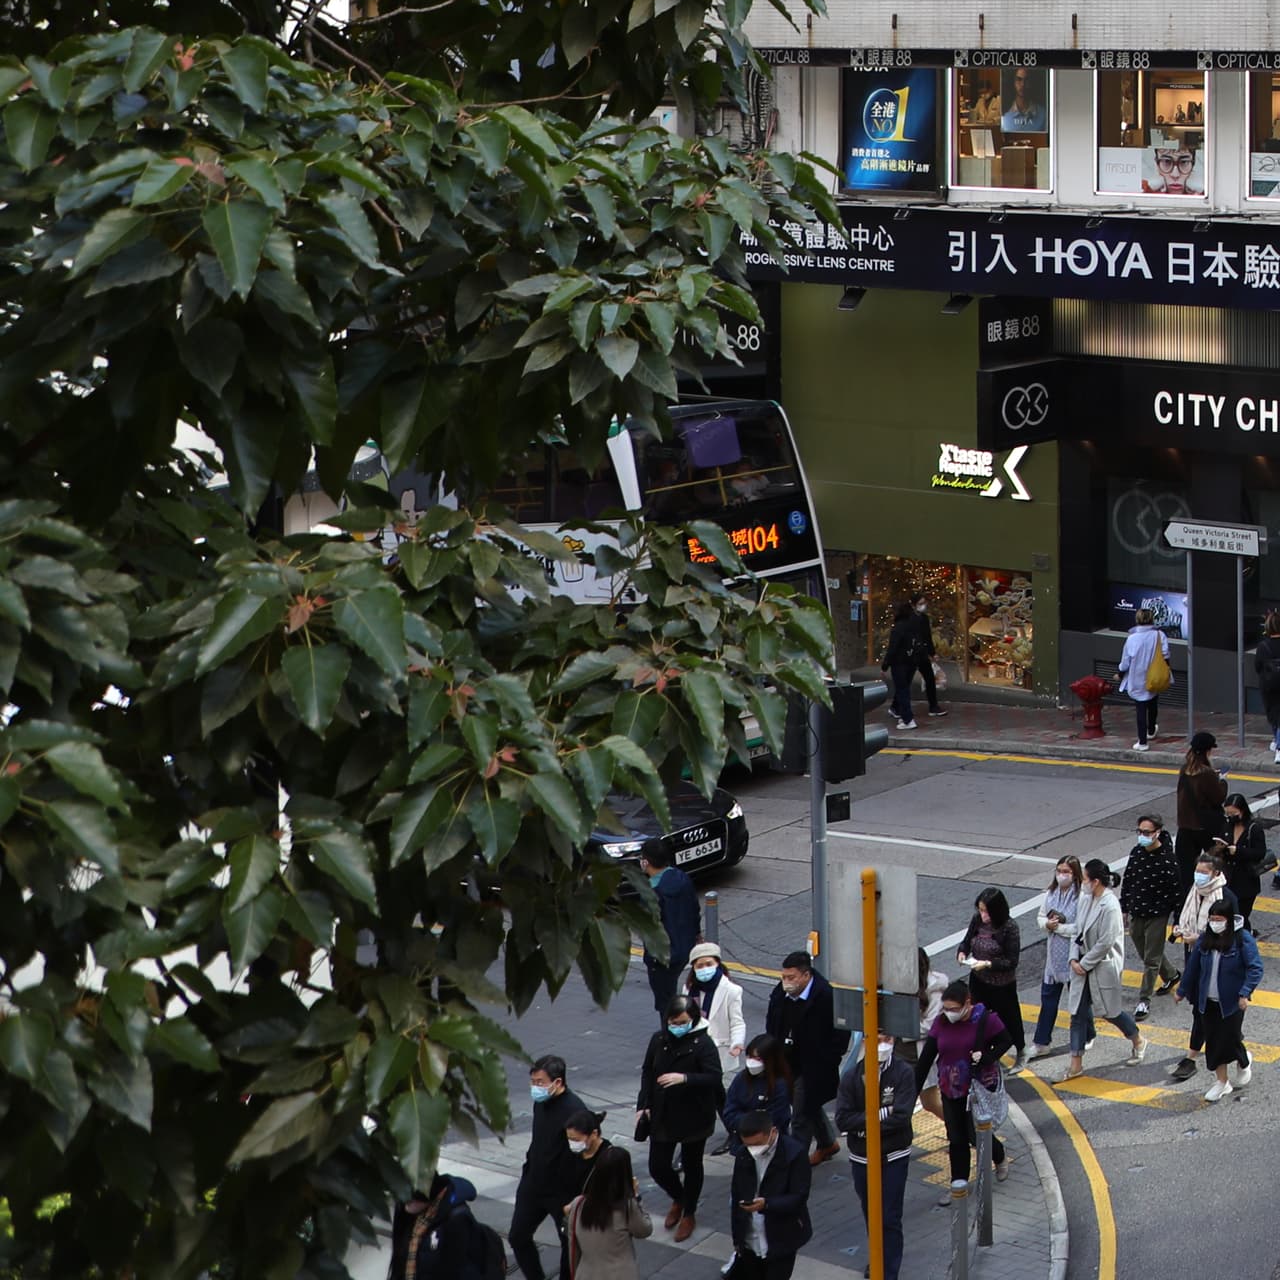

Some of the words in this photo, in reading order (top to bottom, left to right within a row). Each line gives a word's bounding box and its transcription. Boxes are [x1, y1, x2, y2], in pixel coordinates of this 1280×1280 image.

[797, 49, 810, 64] 88
[972, 51, 1022, 67] OPTICAL
[1023, 52, 1037, 67] 88
[1217, 53, 1274, 69] OPTICAL
[871, 101, 896, 118] 全港
[817, 256, 846, 269] LENS
[848, 257, 895, 272] CENTRE
[948, 230, 1018, 275] 引入
[1028, 236, 1153, 281] HOYA
[736, 325, 760, 351] 88
[1154, 390, 1226, 428] CITY
[938, 458, 993, 477] Republic
[748, 523, 779, 554] 104
[1183, 526, 1204, 535] Queen
[1205, 529, 1229, 538] Victoria
[1231, 531, 1252, 541] Street
[678, 850, 692, 861] YE
[695, 841, 720, 856] 6634
